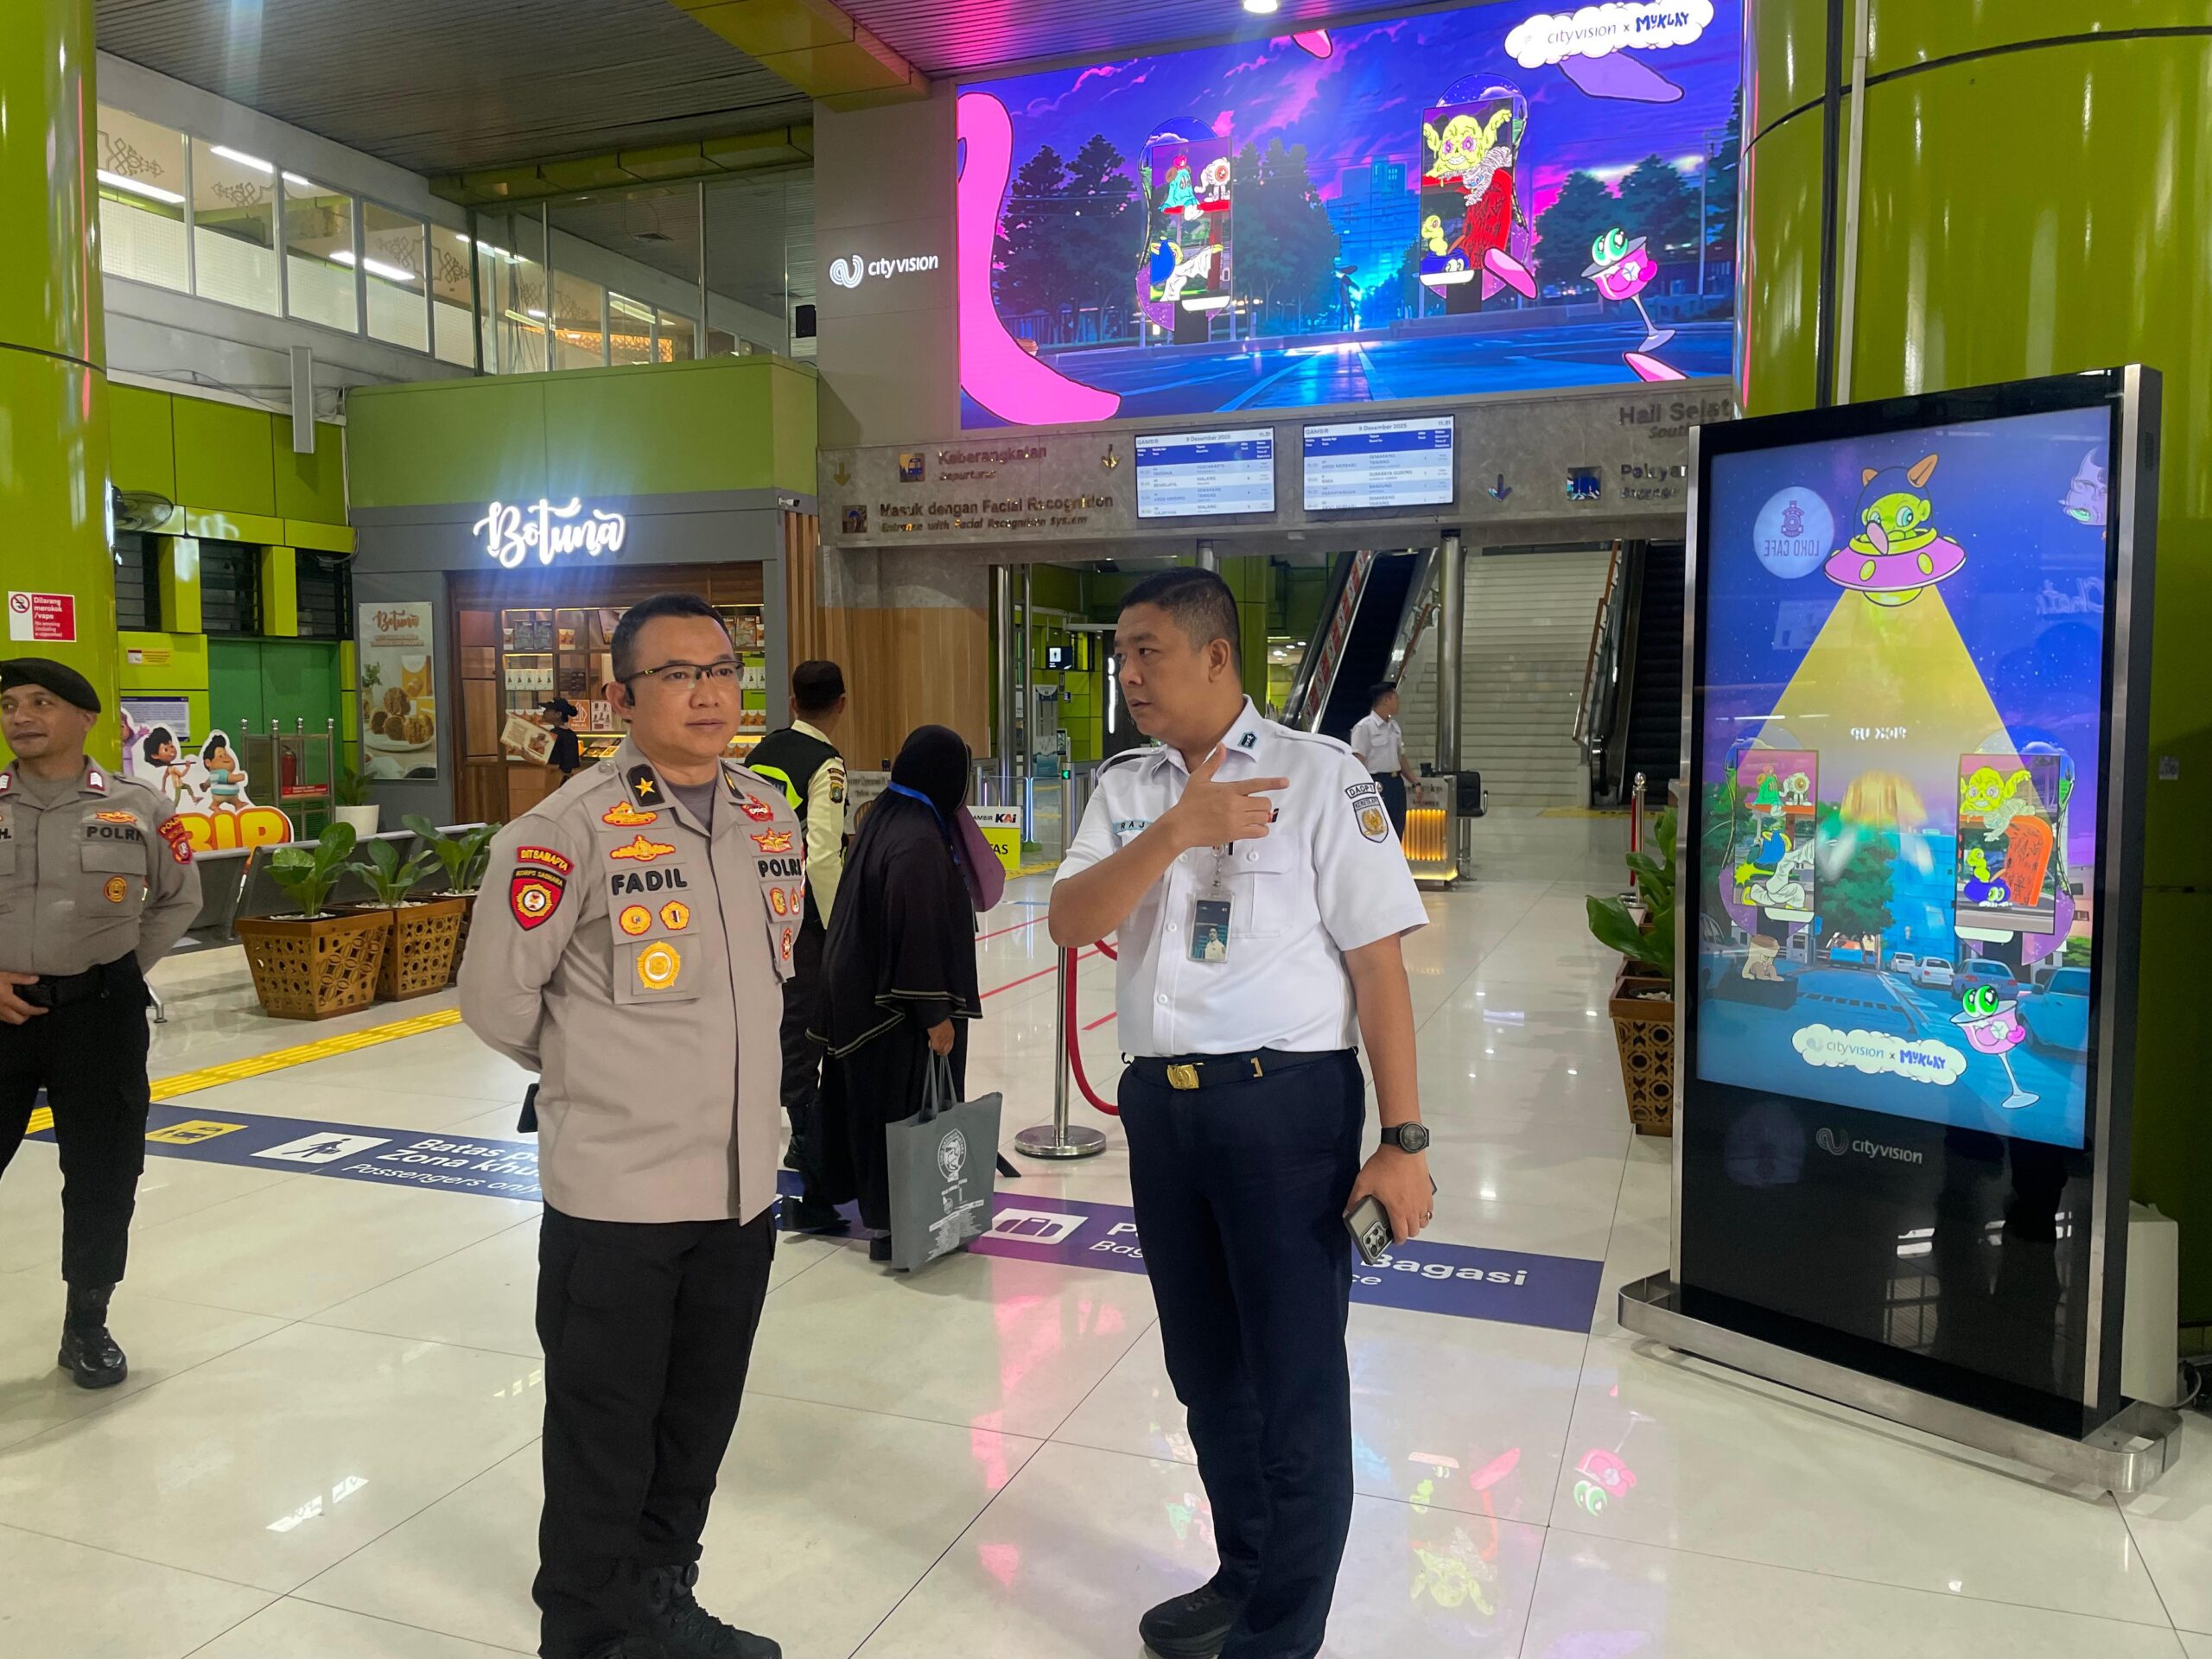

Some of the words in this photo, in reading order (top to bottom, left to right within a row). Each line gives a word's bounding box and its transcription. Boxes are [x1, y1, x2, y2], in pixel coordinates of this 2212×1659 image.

[1619, 404, 1661, 426] Hall
[938, 446, 1046, 465] Keberangkatan
[880, 503, 923, 518] Masuk
[928, 502, 978, 518] dengan
[982, 499, 1022, 514] Facial
[1028, 495, 1113, 513] Recognition
[473, 497, 626, 569] Botuna
[34, 597, 60, 607] Dilarang
[1349, 785, 1370, 796] DAOP
[757, 858, 802, 878] POLRI
[611, 868, 688, 896] FADIL
[409, 1139, 505, 1158] Batas
[1852, 1140, 1923, 1164] cityvision
[342, 1163, 486, 1186] Passengers
[376, 1149, 469, 1167] Zona
[470, 1160, 539, 1177] khu
[1361, 1254, 1528, 1287] Bagasi
